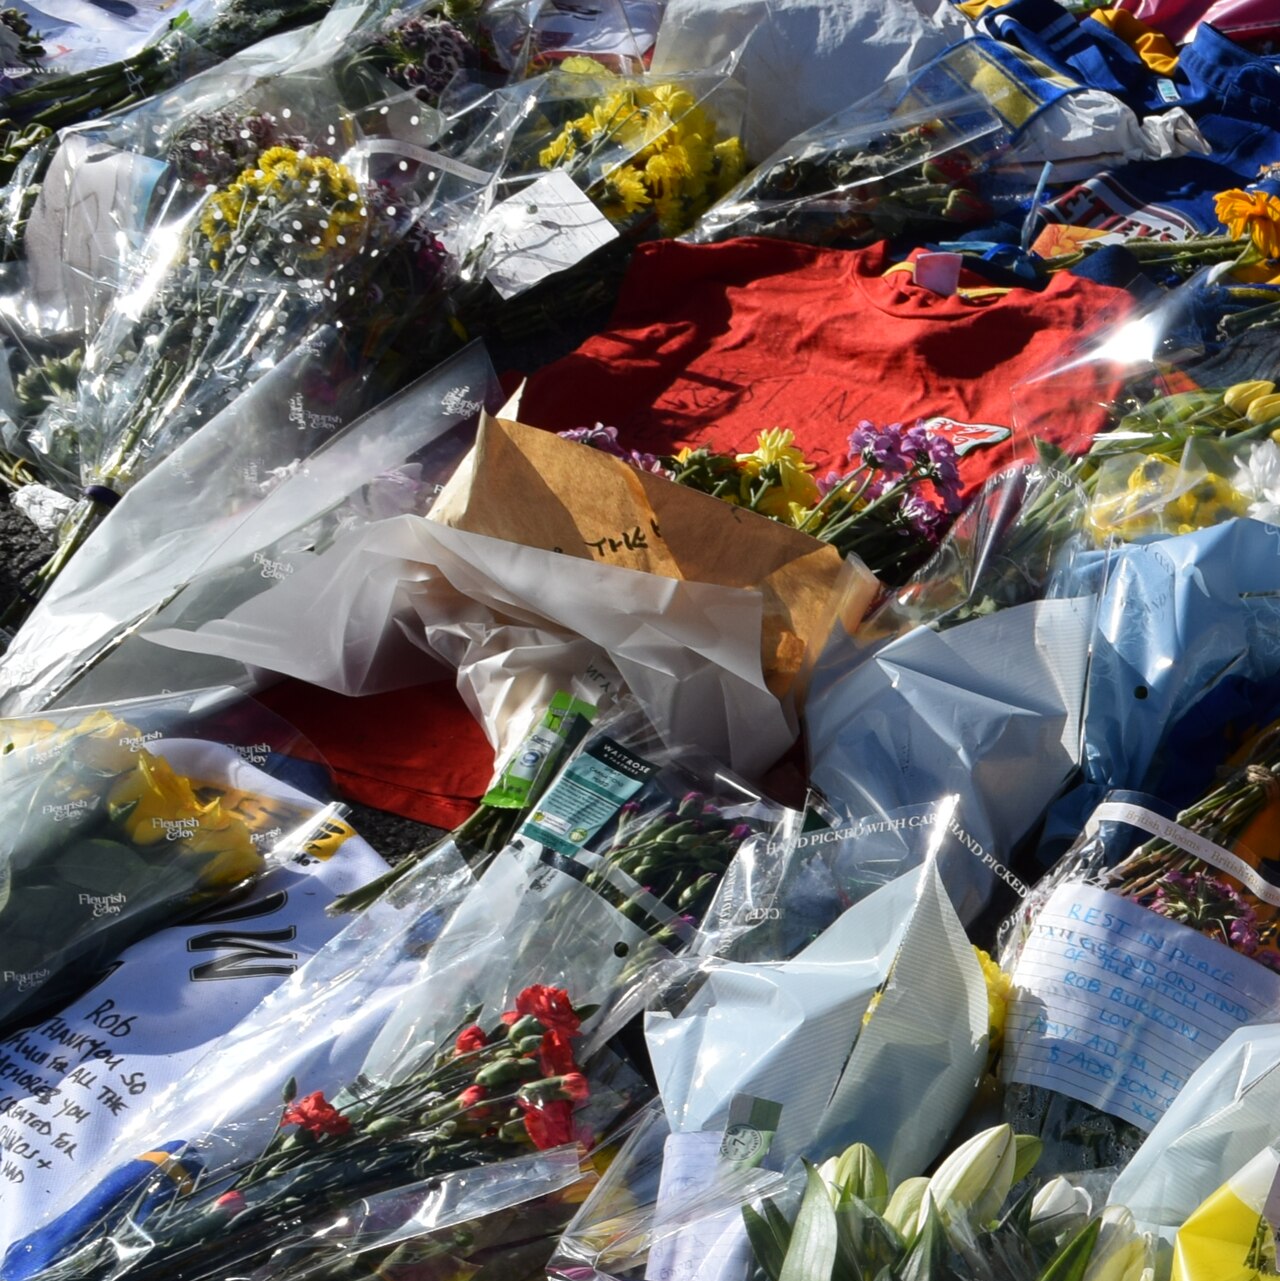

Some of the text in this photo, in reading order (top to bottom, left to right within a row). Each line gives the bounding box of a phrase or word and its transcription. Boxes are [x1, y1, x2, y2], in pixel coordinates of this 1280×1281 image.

[603, 743, 652, 775] WAITROSE
[152, 817, 200, 830] Flourish
[950, 817, 1030, 900] HAND PICKED
[78, 892, 127, 906] Flourish
[1069, 903, 1131, 935] REST
[1140, 931, 1165, 950] IN
[1063, 970, 1102, 994] ROB
[1140, 975, 1199, 1012] PITCH
